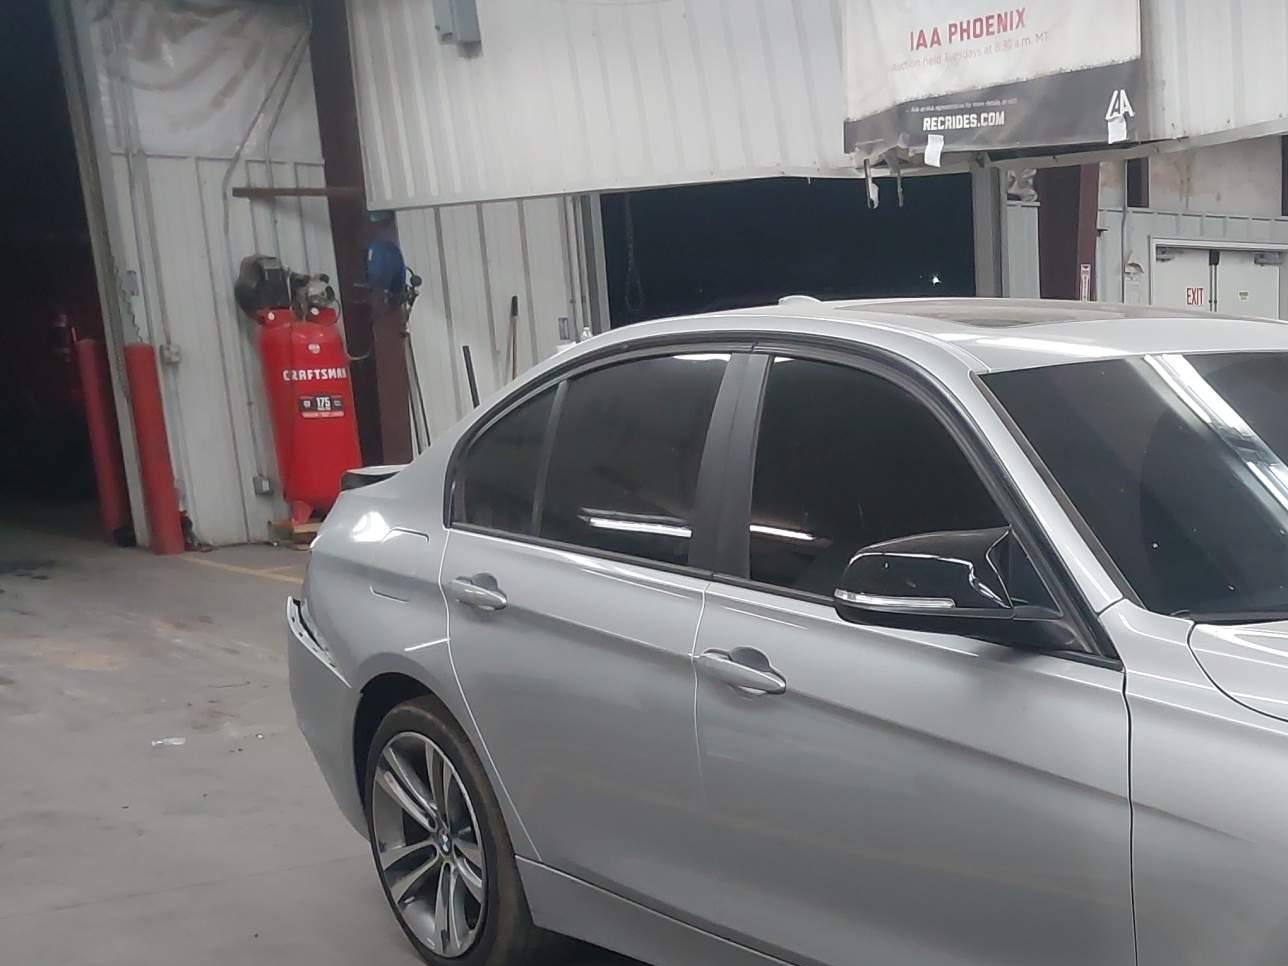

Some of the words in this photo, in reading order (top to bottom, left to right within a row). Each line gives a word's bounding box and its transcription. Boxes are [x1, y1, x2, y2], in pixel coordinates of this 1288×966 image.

[909, 27, 942, 51] IAA
[948, 8, 1026, 44] PHOENIX
[922, 111, 1005, 131] RECRIDES.COM
[1186, 287, 1204, 305] EXIT
[316, 397, 331, 407] 175
